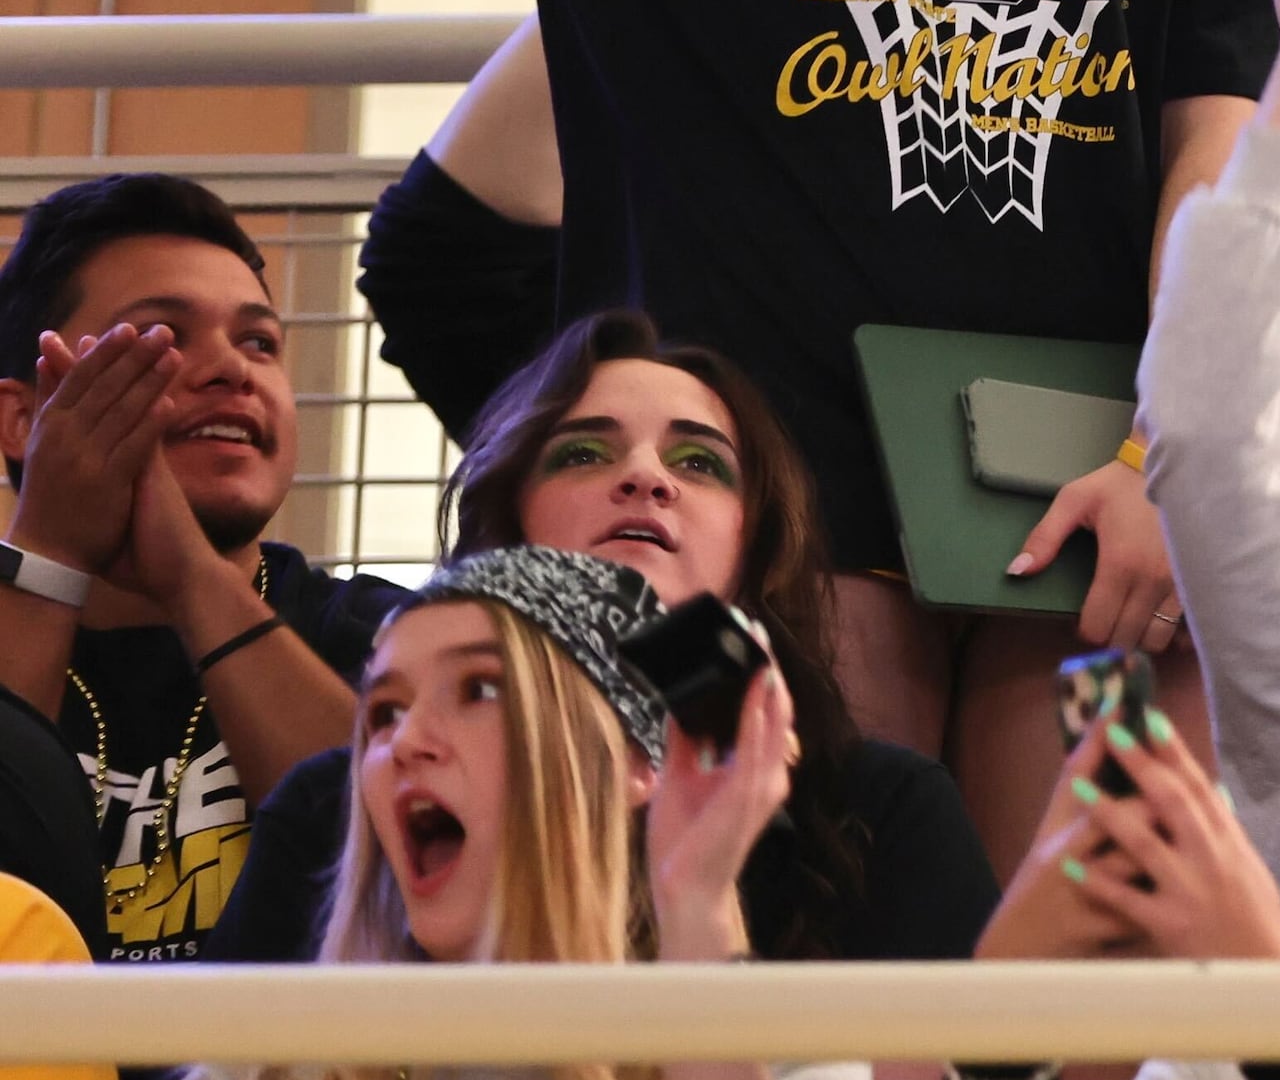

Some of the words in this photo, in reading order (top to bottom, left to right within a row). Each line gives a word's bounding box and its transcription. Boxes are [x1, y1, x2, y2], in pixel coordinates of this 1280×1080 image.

[776, 27, 932, 117] Owl
[939, 32, 1136, 104] Nation
[971, 114, 1020, 133] MEN'S
[1026, 117, 1115, 142] BASKETBALL
[77, 741, 246, 868] THE
[111, 941, 199, 962] PORTS
